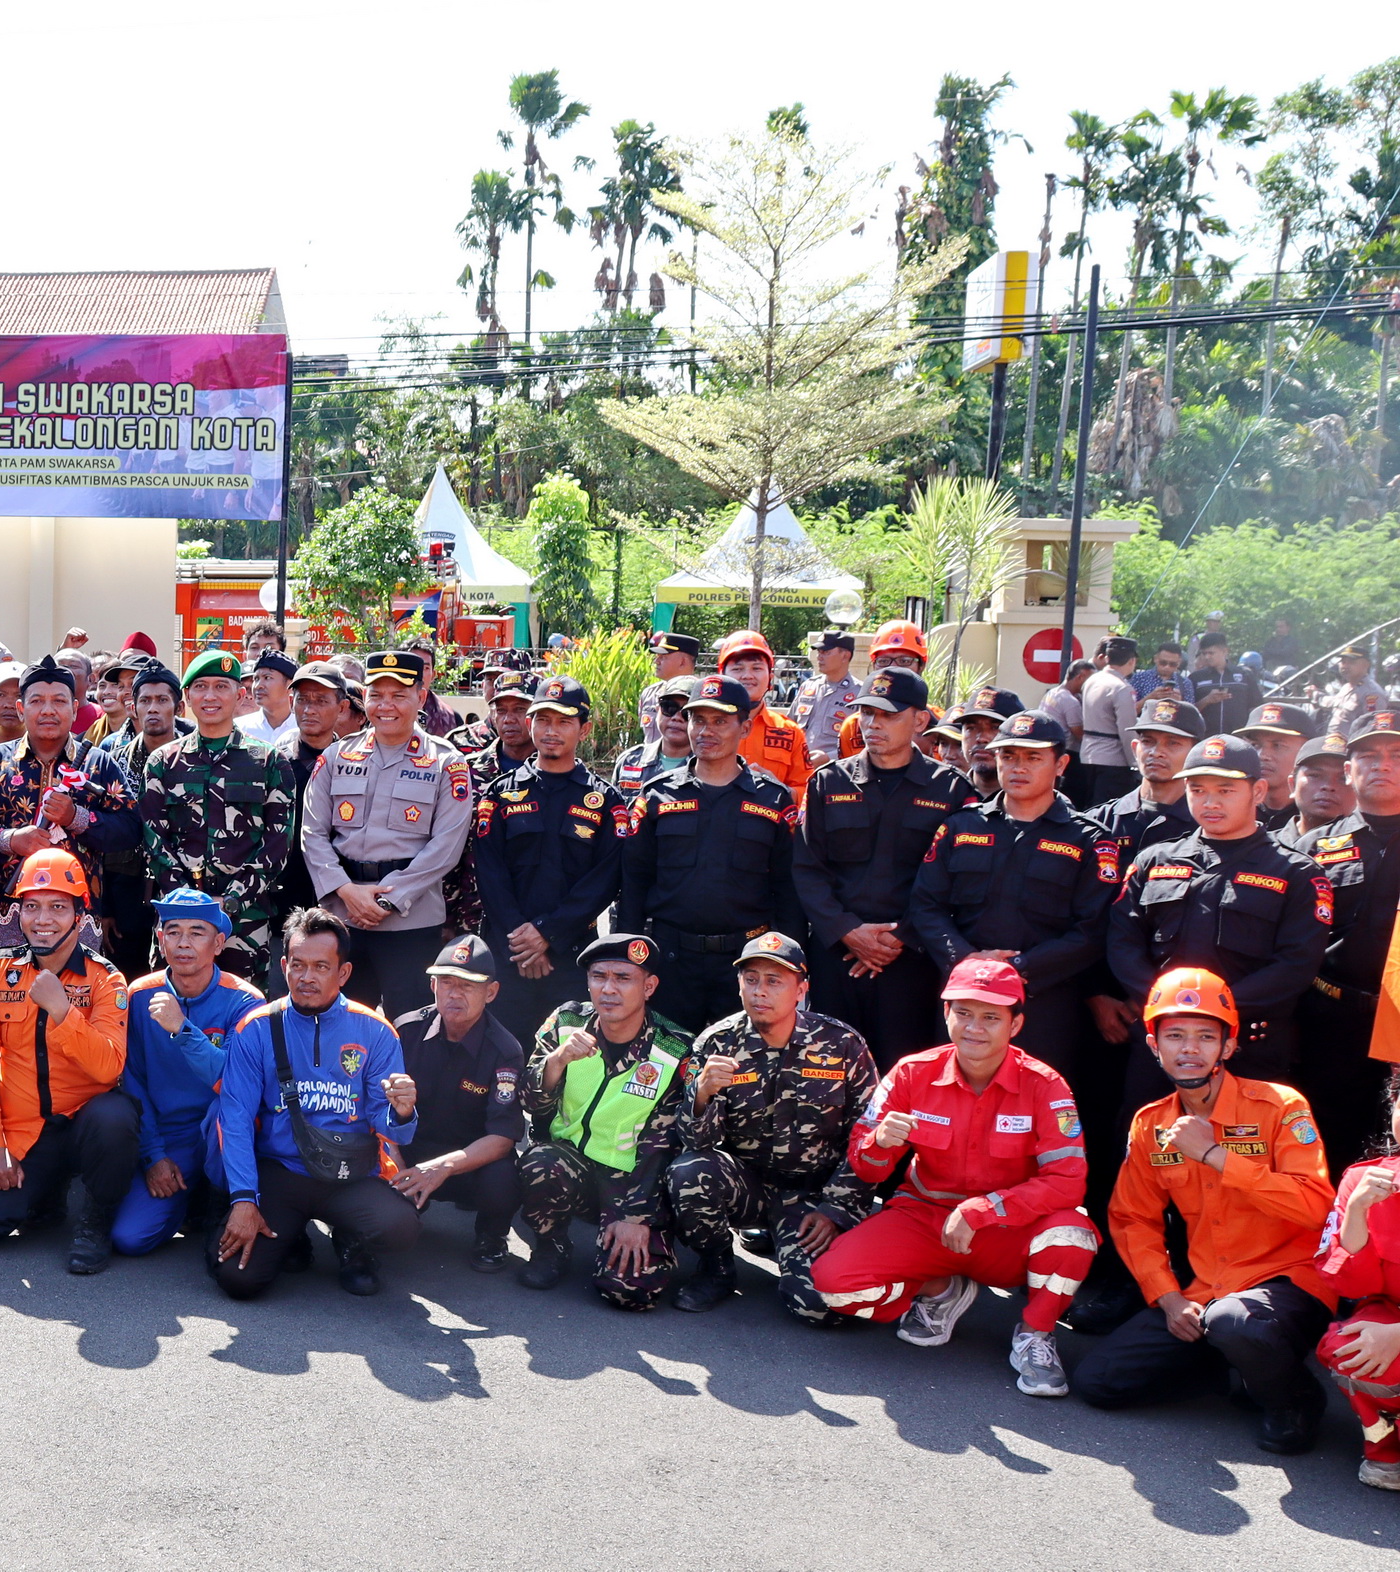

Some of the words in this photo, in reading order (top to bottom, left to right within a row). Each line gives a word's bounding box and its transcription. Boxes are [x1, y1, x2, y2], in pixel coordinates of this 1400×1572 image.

[16, 381, 196, 416] SWAKARSA
[190, 417, 277, 452] KOTA
[20, 458, 47, 470] PAM
[48, 458, 116, 470] SWAKARSA
[54, 475, 128, 487] KAMTIBMAS
[129, 475, 170, 488] PASCA
[172, 476, 214, 488] UNJUK
[216, 476, 249, 488] RASA
[470, 592, 495, 600] KOTA
[688, 592, 732, 602] POLRES
[734, 594, 809, 604] PELONGAN
[337, 764, 368, 776] YUDI
[400, 769, 436, 783] POLRI
[506, 803, 532, 815] AMIN
[659, 801, 695, 812] SOLIHIN
[916, 799, 947, 810] SENKOM
[743, 803, 779, 821] SENKOM
[955, 834, 988, 844] HENDRI
[1040, 841, 1081, 859] SENKOM
[1236, 874, 1285, 891] SENKOM
[803, 1069, 843, 1079] BANSER
[296, 1080, 351, 1099] KALONGAN
[1252, 1144, 1265, 1153] PB
